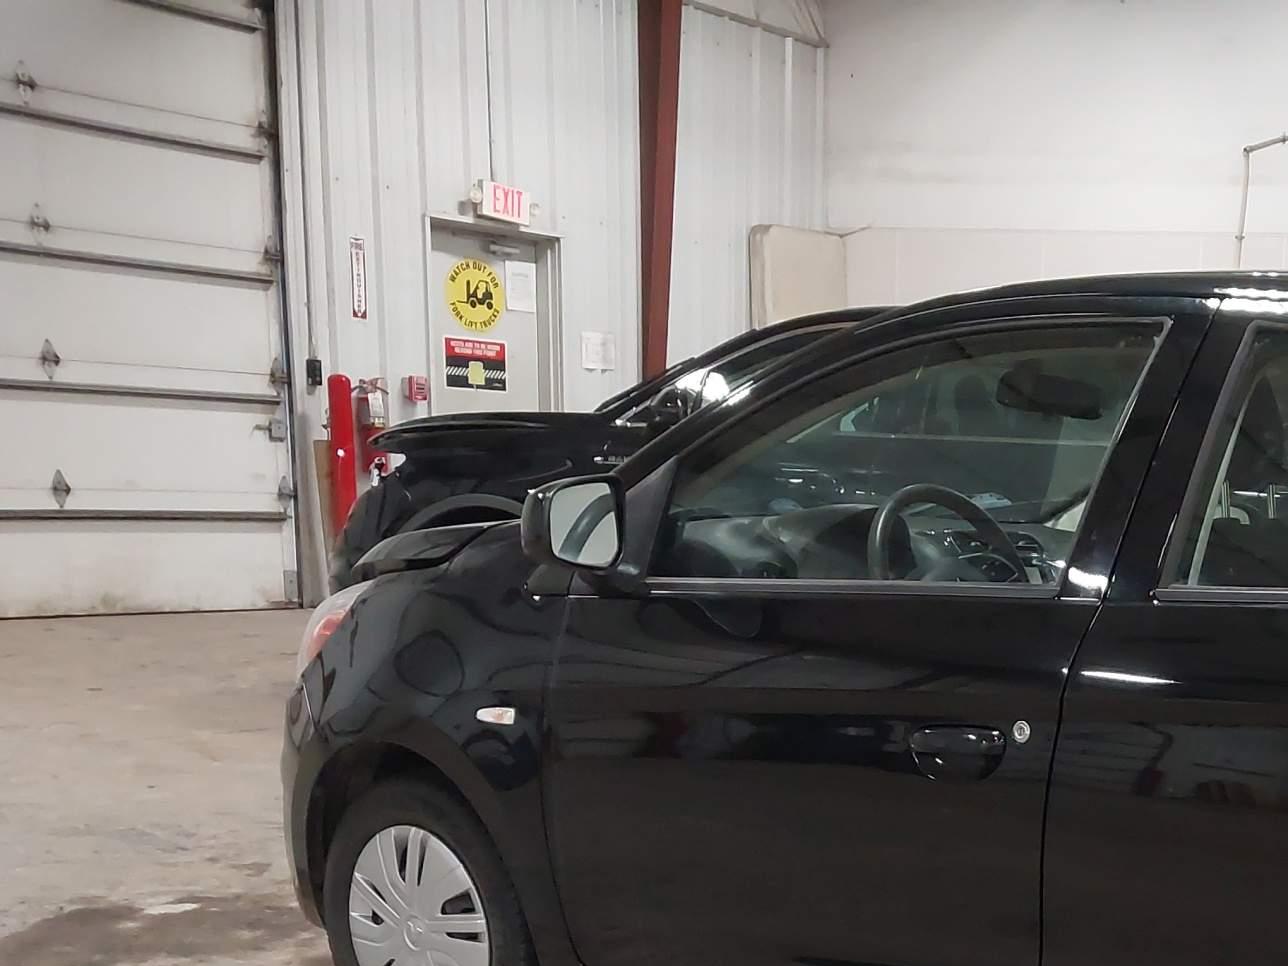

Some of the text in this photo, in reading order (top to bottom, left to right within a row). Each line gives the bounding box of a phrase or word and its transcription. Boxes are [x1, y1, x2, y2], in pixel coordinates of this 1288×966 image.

[493, 184, 523, 219] EXIT
[449, 261, 471, 283] WATCH
[472, 261, 487, 273] OUT
[487, 271, 500, 289] FOR
[450, 301, 500, 331] FORK LIFT TRUCKS
